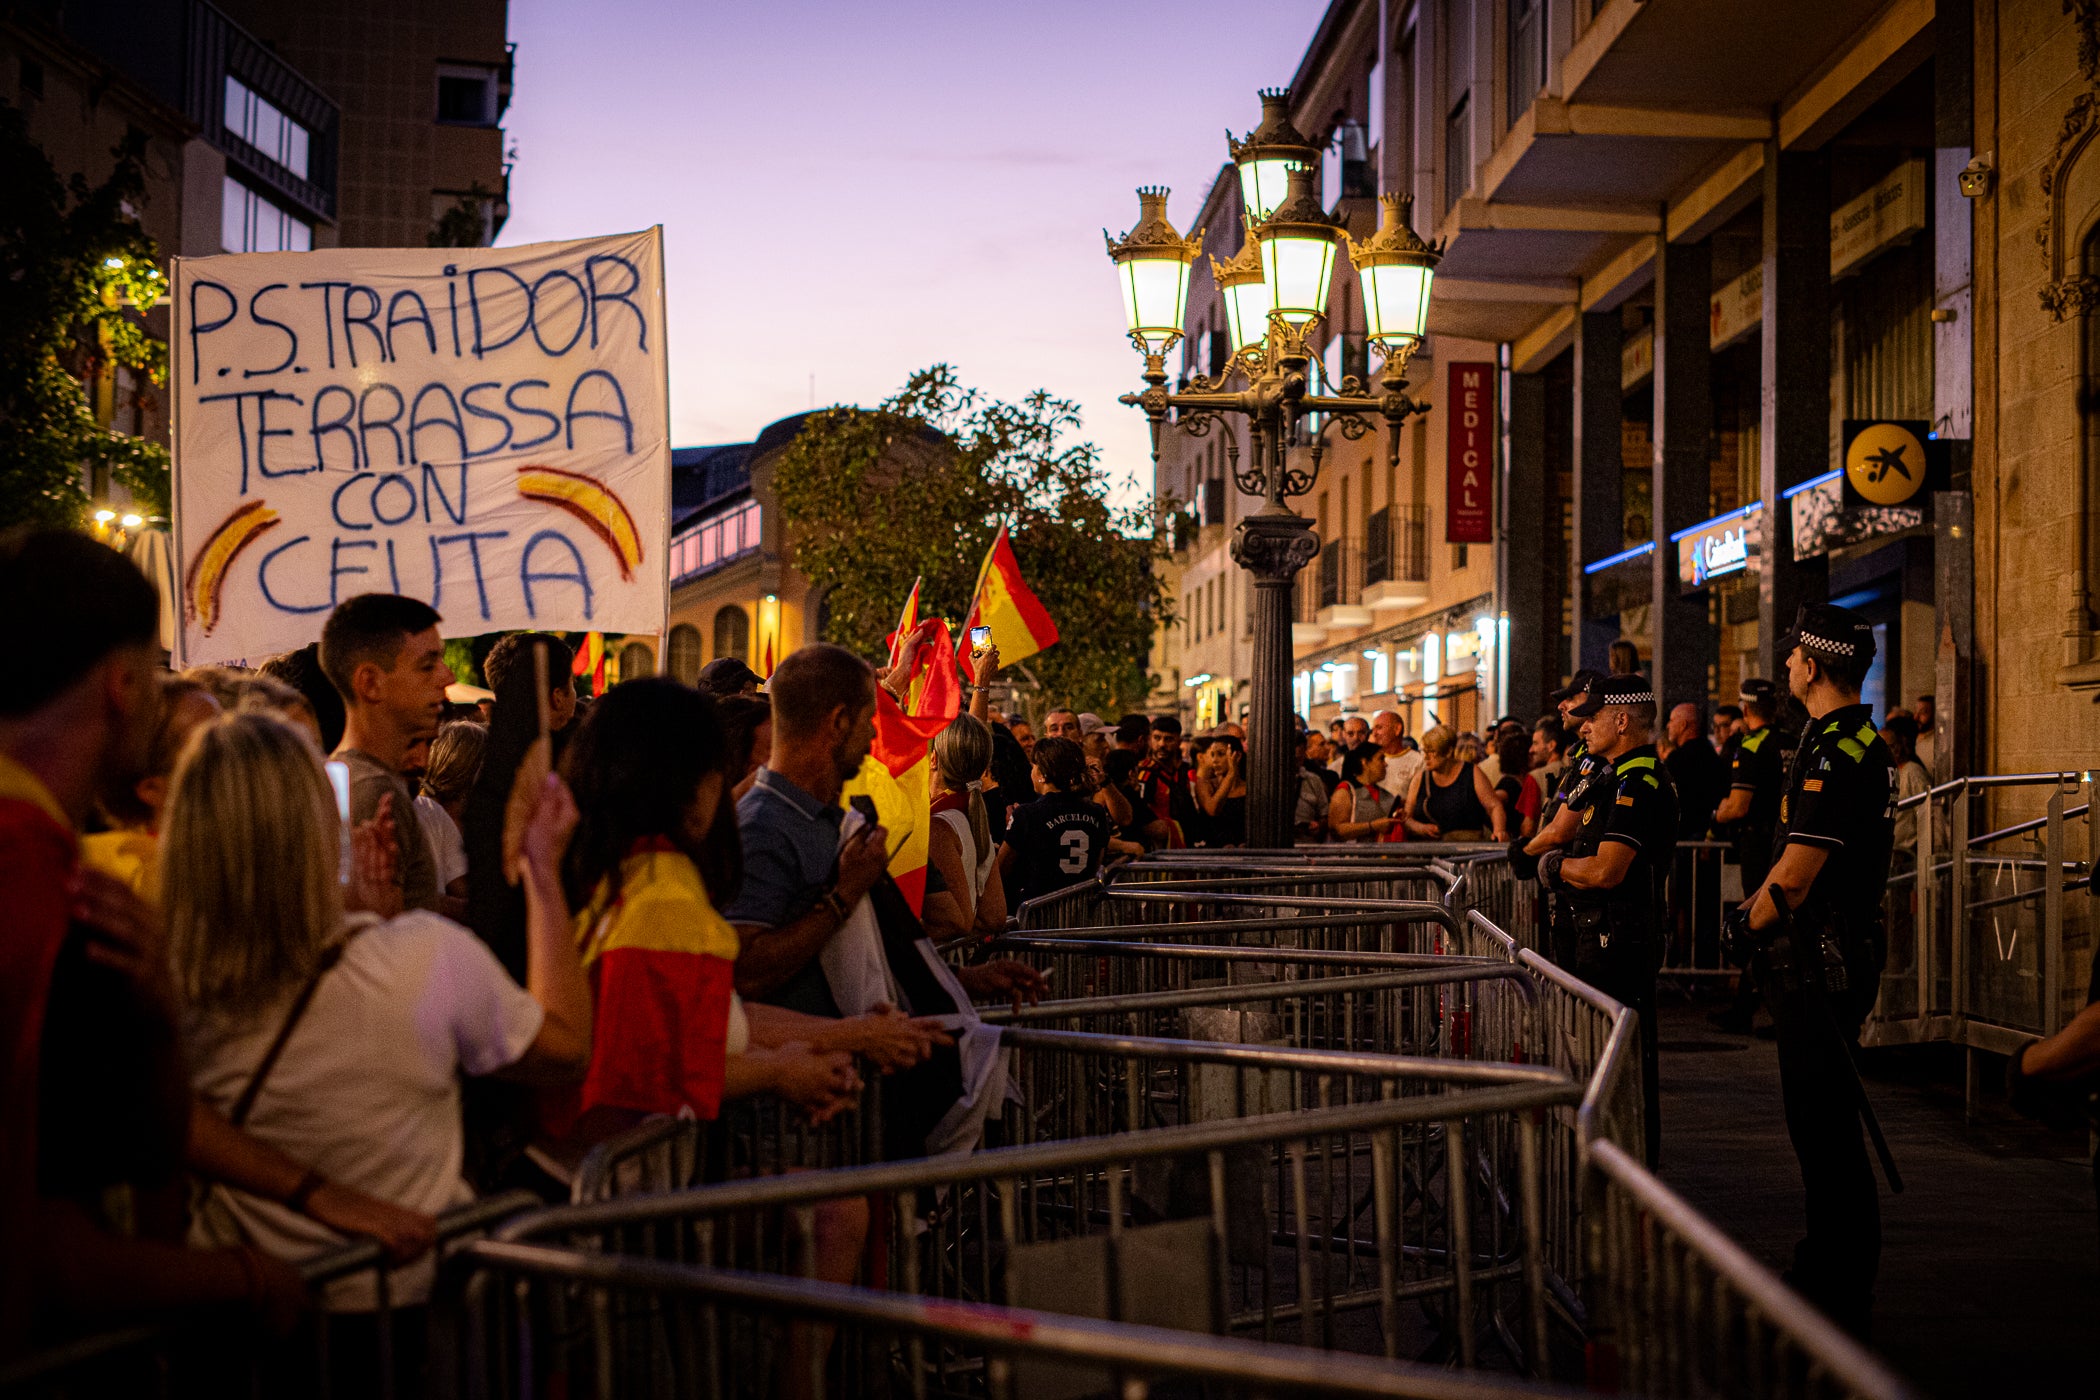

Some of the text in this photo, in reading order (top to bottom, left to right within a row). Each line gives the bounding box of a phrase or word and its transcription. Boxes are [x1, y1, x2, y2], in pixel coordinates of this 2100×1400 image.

[199, 369, 635, 495] TERRASSA
[1462, 371, 1480, 507] MEDICAL
[332, 462, 468, 530] CON
[1045, 812, 1100, 830] BARCELONA
[1059, 829, 1090, 874] 3
